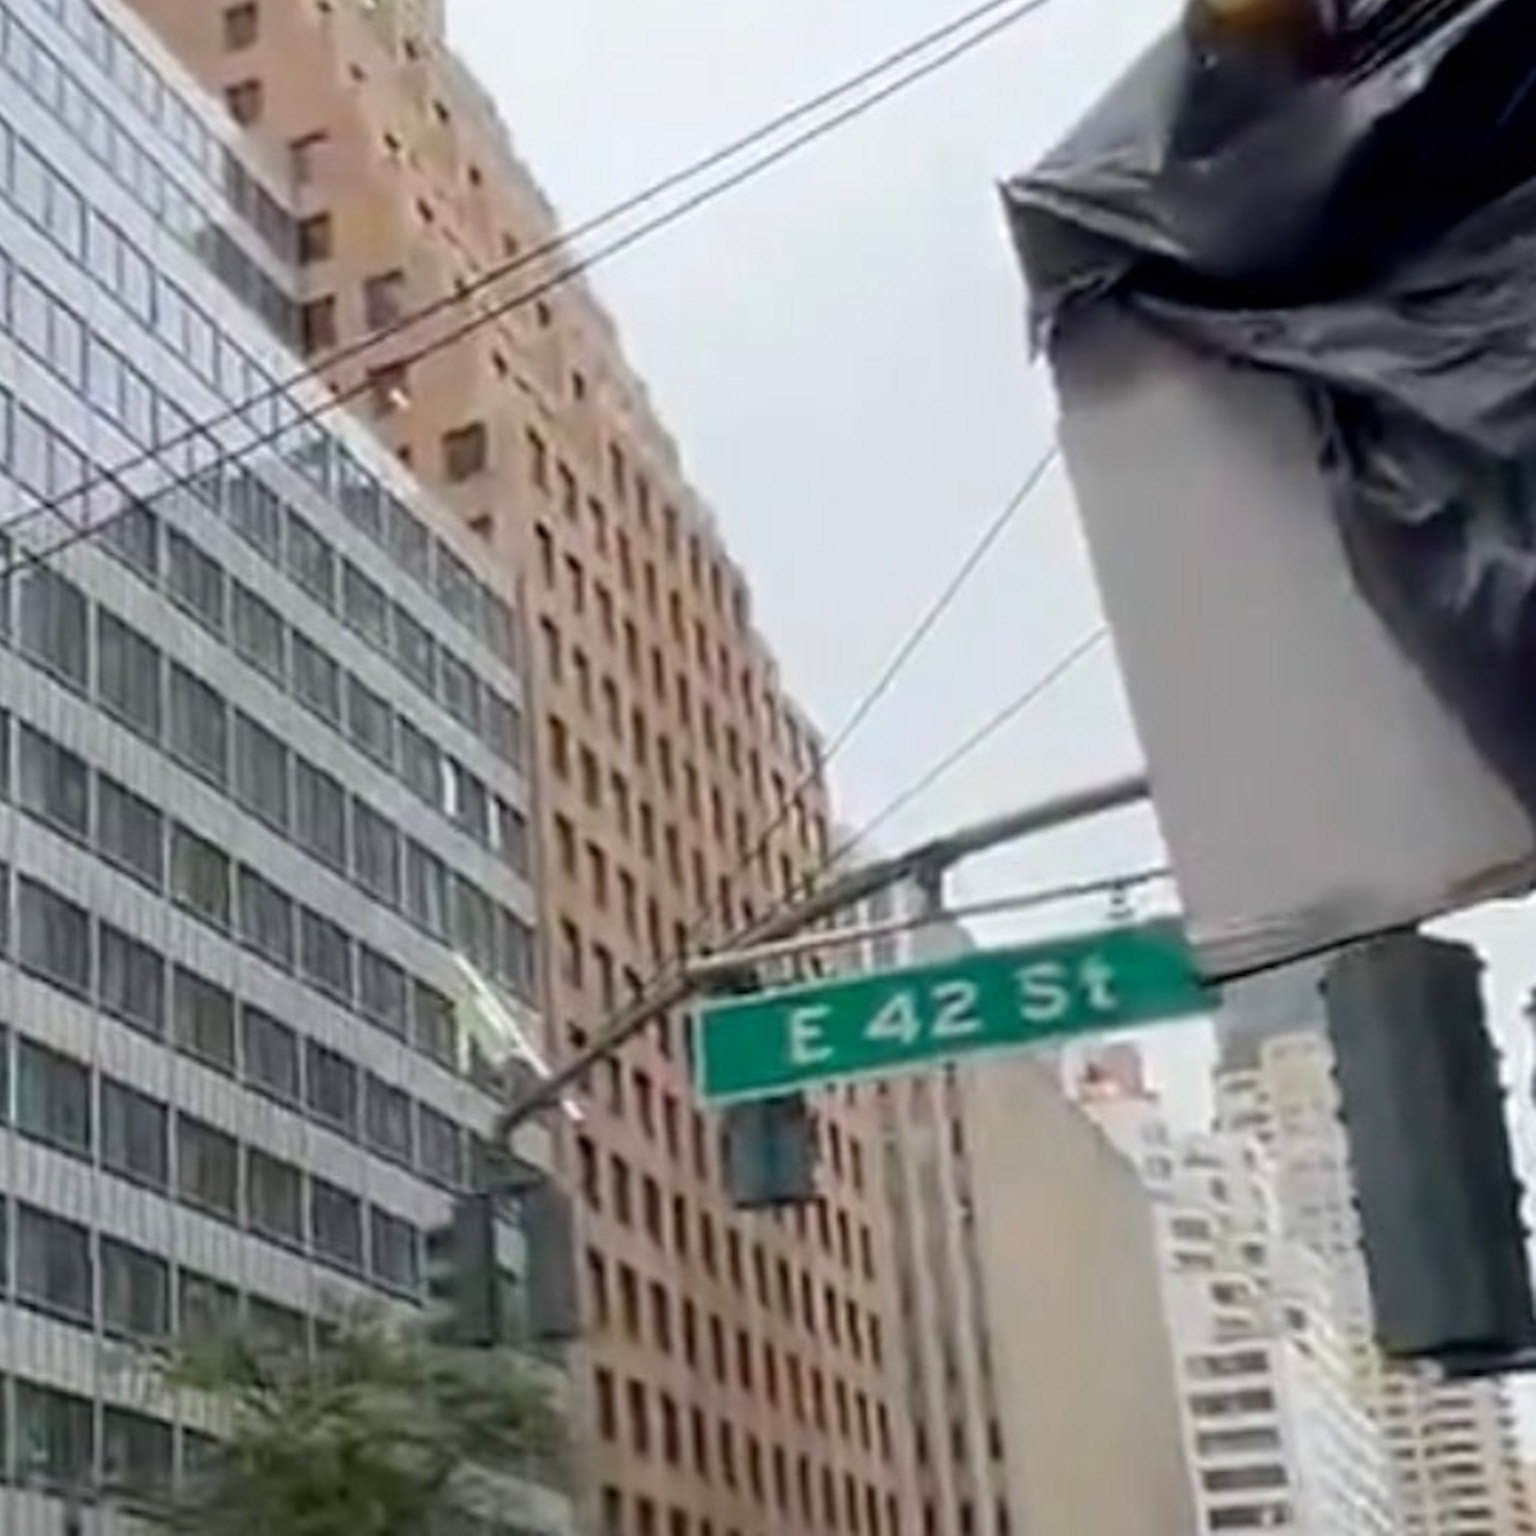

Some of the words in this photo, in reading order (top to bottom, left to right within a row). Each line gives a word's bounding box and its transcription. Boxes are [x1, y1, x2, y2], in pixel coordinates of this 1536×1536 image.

[787, 1004, 835, 1065] E
[864, 980, 981, 1046] 42
[1015, 953, 1118, 1021] St
